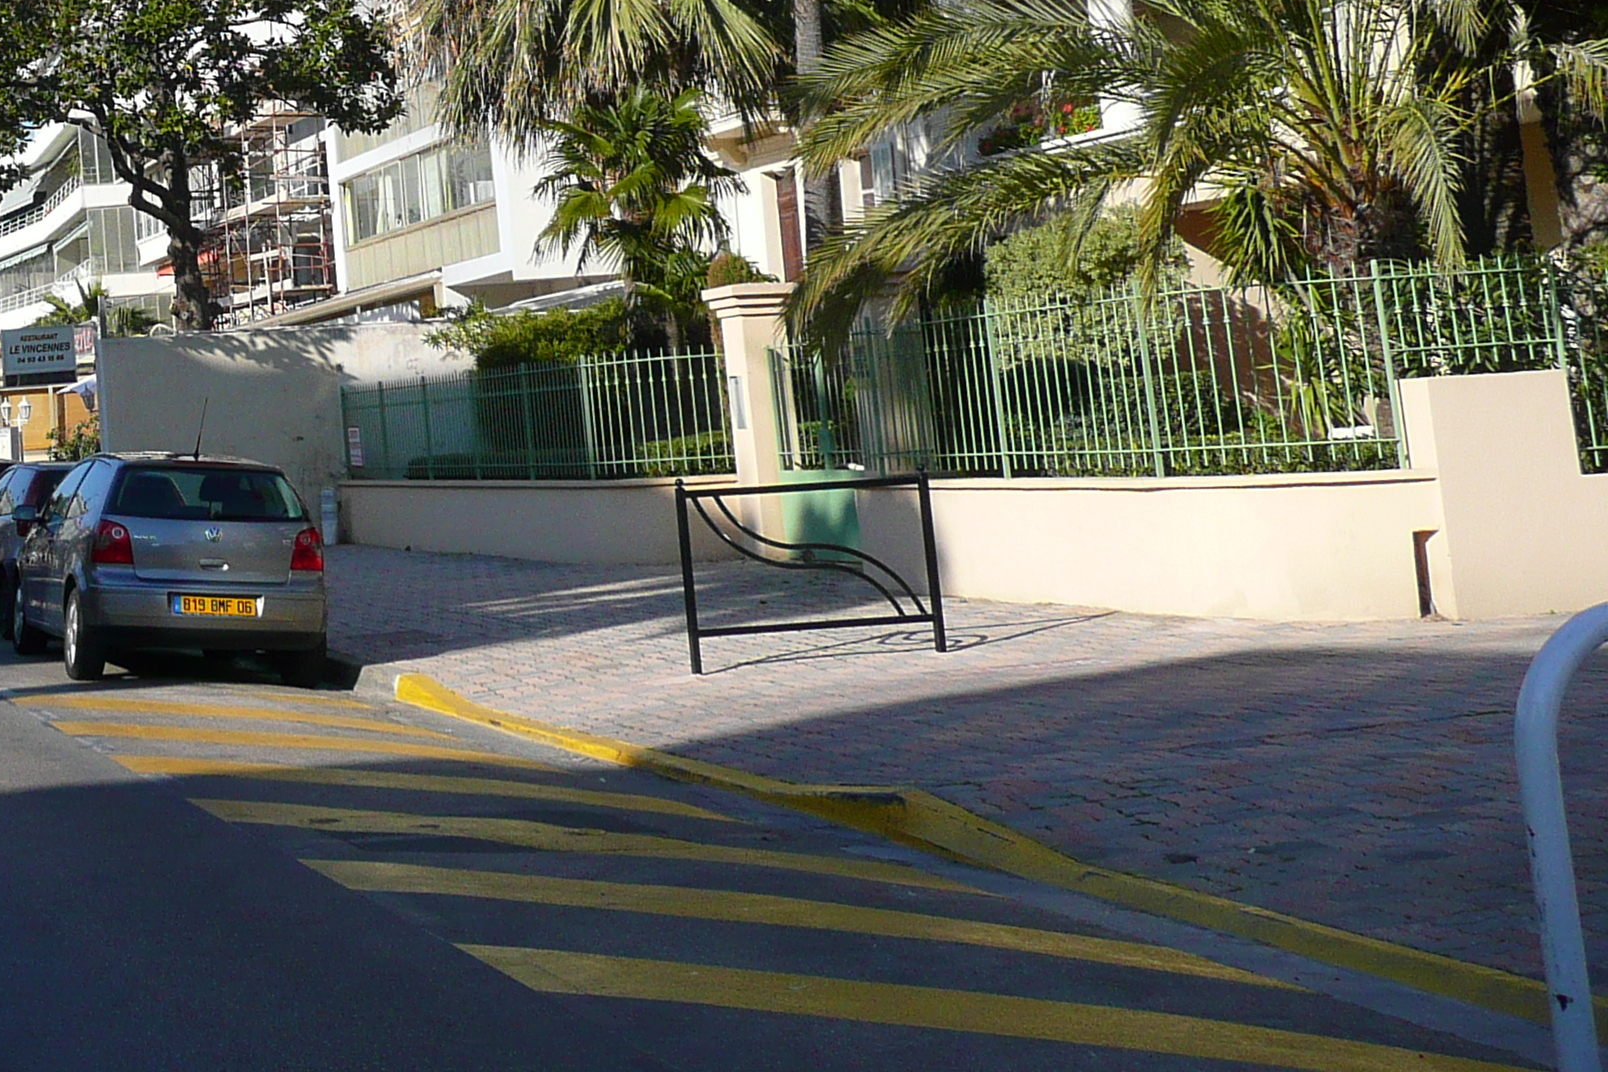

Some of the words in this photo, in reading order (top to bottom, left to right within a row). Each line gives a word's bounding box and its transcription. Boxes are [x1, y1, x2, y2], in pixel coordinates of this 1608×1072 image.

[20, 332, 59, 342] RESTAURANT
[9, 345, 20, 355] LE
[21, 341, 71, 354] VINCENNES
[183, 598, 206, 612] 819
[210, 599, 232, 613] BMF
[237, 600, 252, 614] 06
